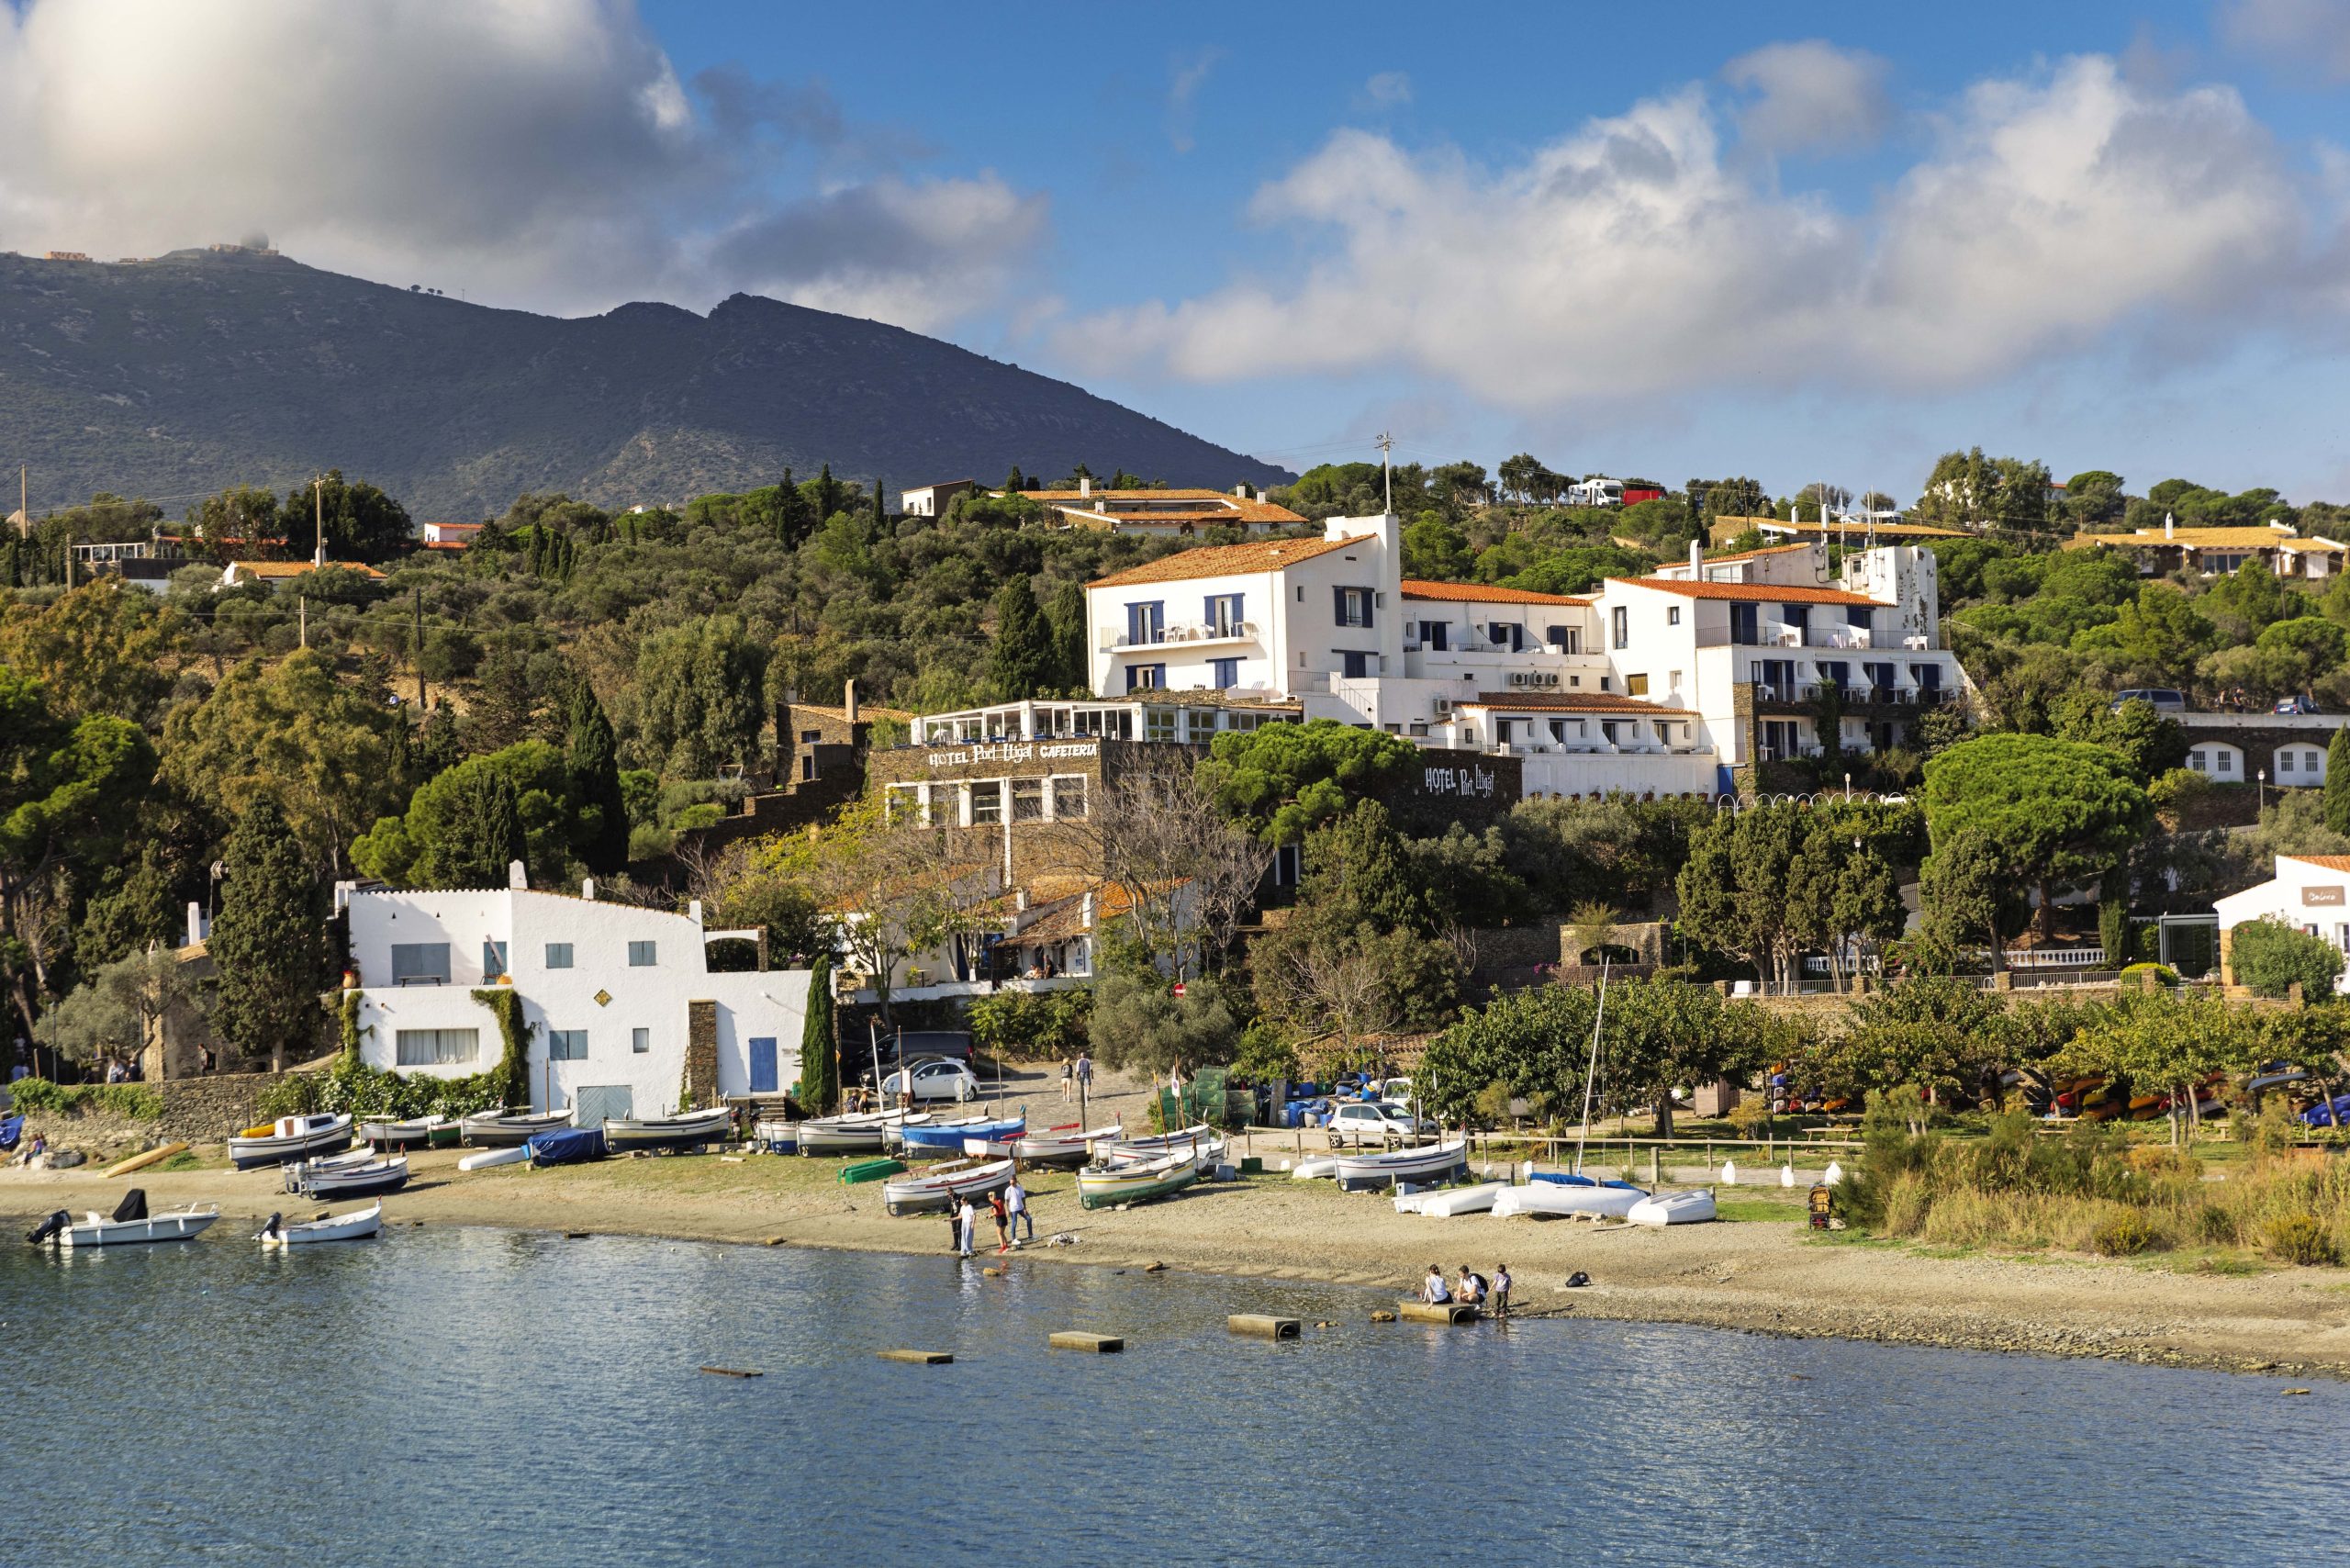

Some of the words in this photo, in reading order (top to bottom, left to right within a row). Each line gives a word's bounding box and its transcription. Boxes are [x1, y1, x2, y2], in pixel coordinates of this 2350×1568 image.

[929, 752, 968, 767] HOTEL
[973, 745, 996, 764] Port
[1040, 745, 1097, 758] CAFETERIA
[1425, 767, 1457, 793] HOTEL
[1460, 768, 1473, 796] Port
